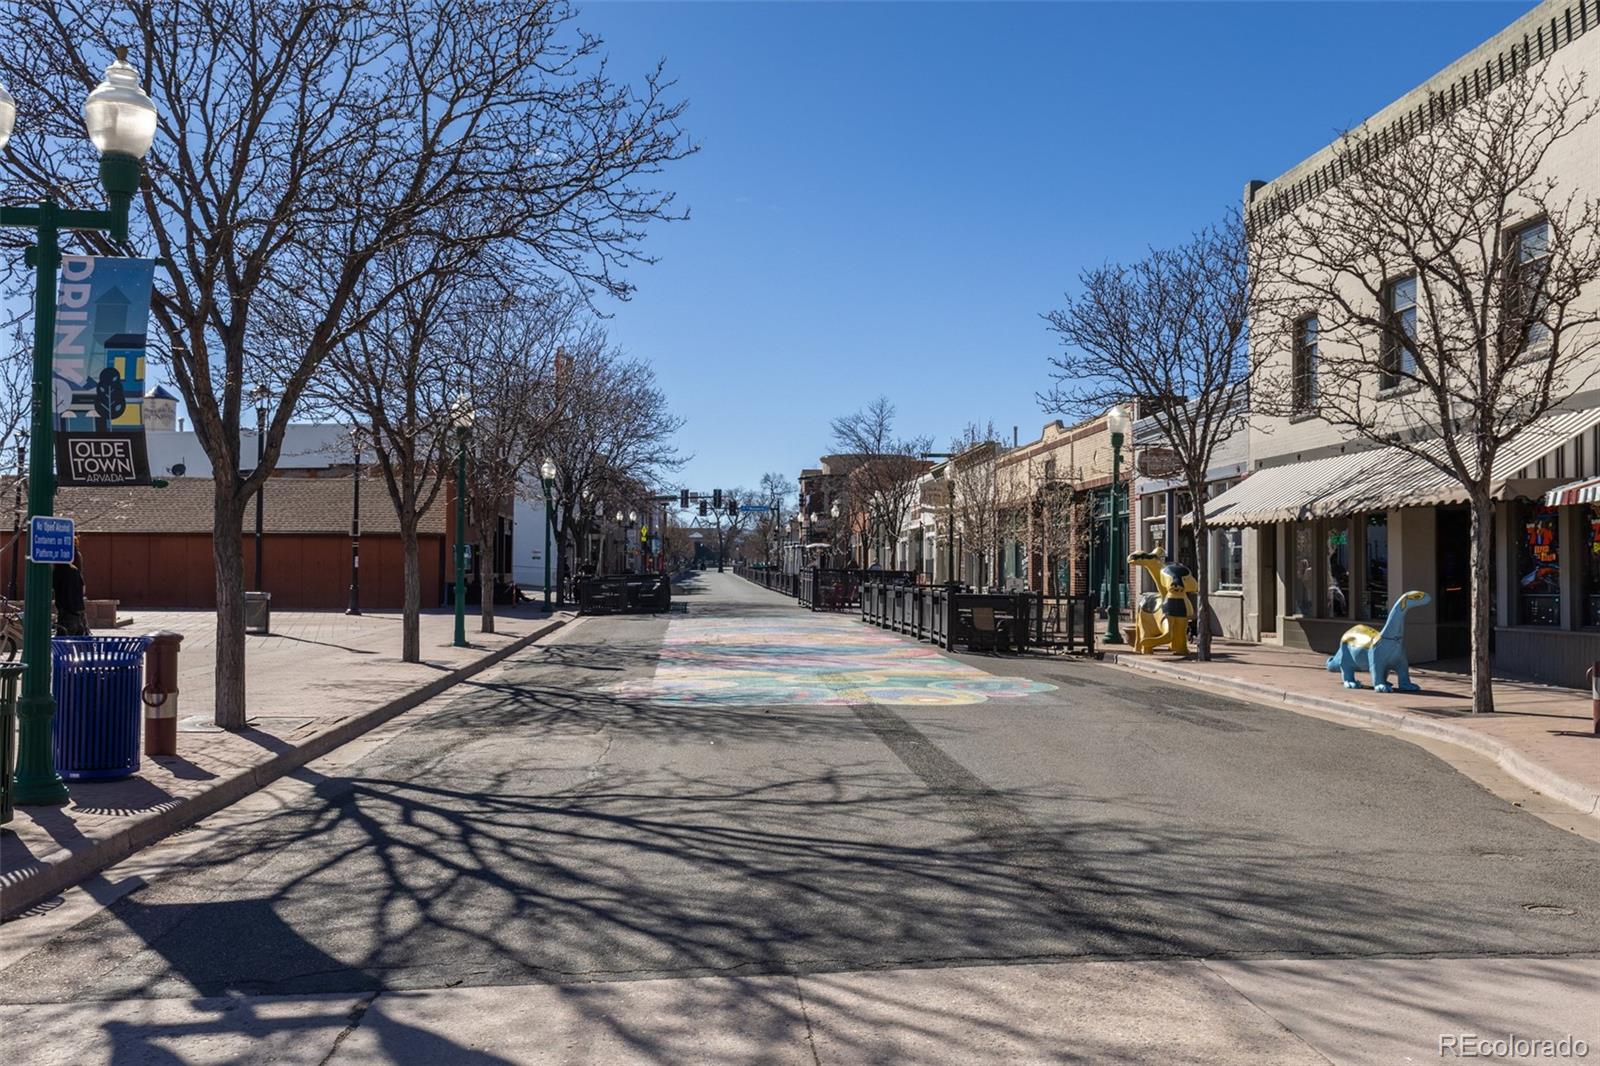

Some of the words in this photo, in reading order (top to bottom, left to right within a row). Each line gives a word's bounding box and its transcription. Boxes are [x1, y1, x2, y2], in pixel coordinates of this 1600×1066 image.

[53, 256, 95, 387] DRINK
[75, 442, 125, 458] OLDE
[73, 458, 132, 474] TOWN
[86, 474, 125, 482] ARVADA
